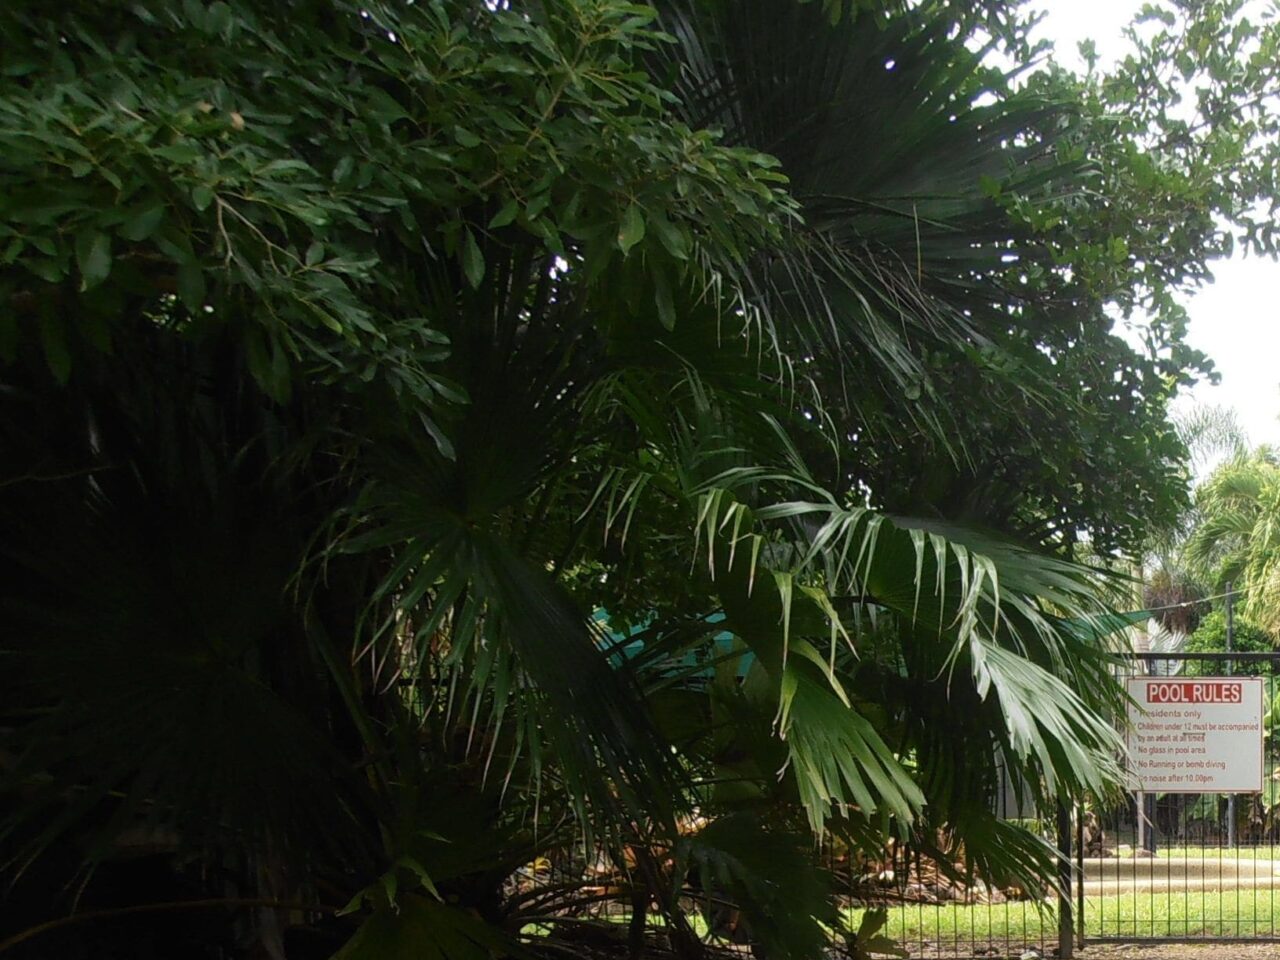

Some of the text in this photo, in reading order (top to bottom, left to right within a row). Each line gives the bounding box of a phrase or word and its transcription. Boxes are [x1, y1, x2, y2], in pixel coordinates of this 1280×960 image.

[1149, 684, 1240, 702] POOL RULES
[1141, 709, 1201, 719] esidents only
[1218, 723, 1258, 732] accompanied
[1149, 746, 1166, 755] glass
[1175, 746, 1189, 755] pool
[1138, 760, 1148, 768] No
[1149, 760, 1175, 769] Running
[1186, 760, 1204, 768] bomb
[1206, 760, 1226, 769] diving
[1168, 774, 1183, 782] after
[1185, 774, 1213, 783] 10.00pm
